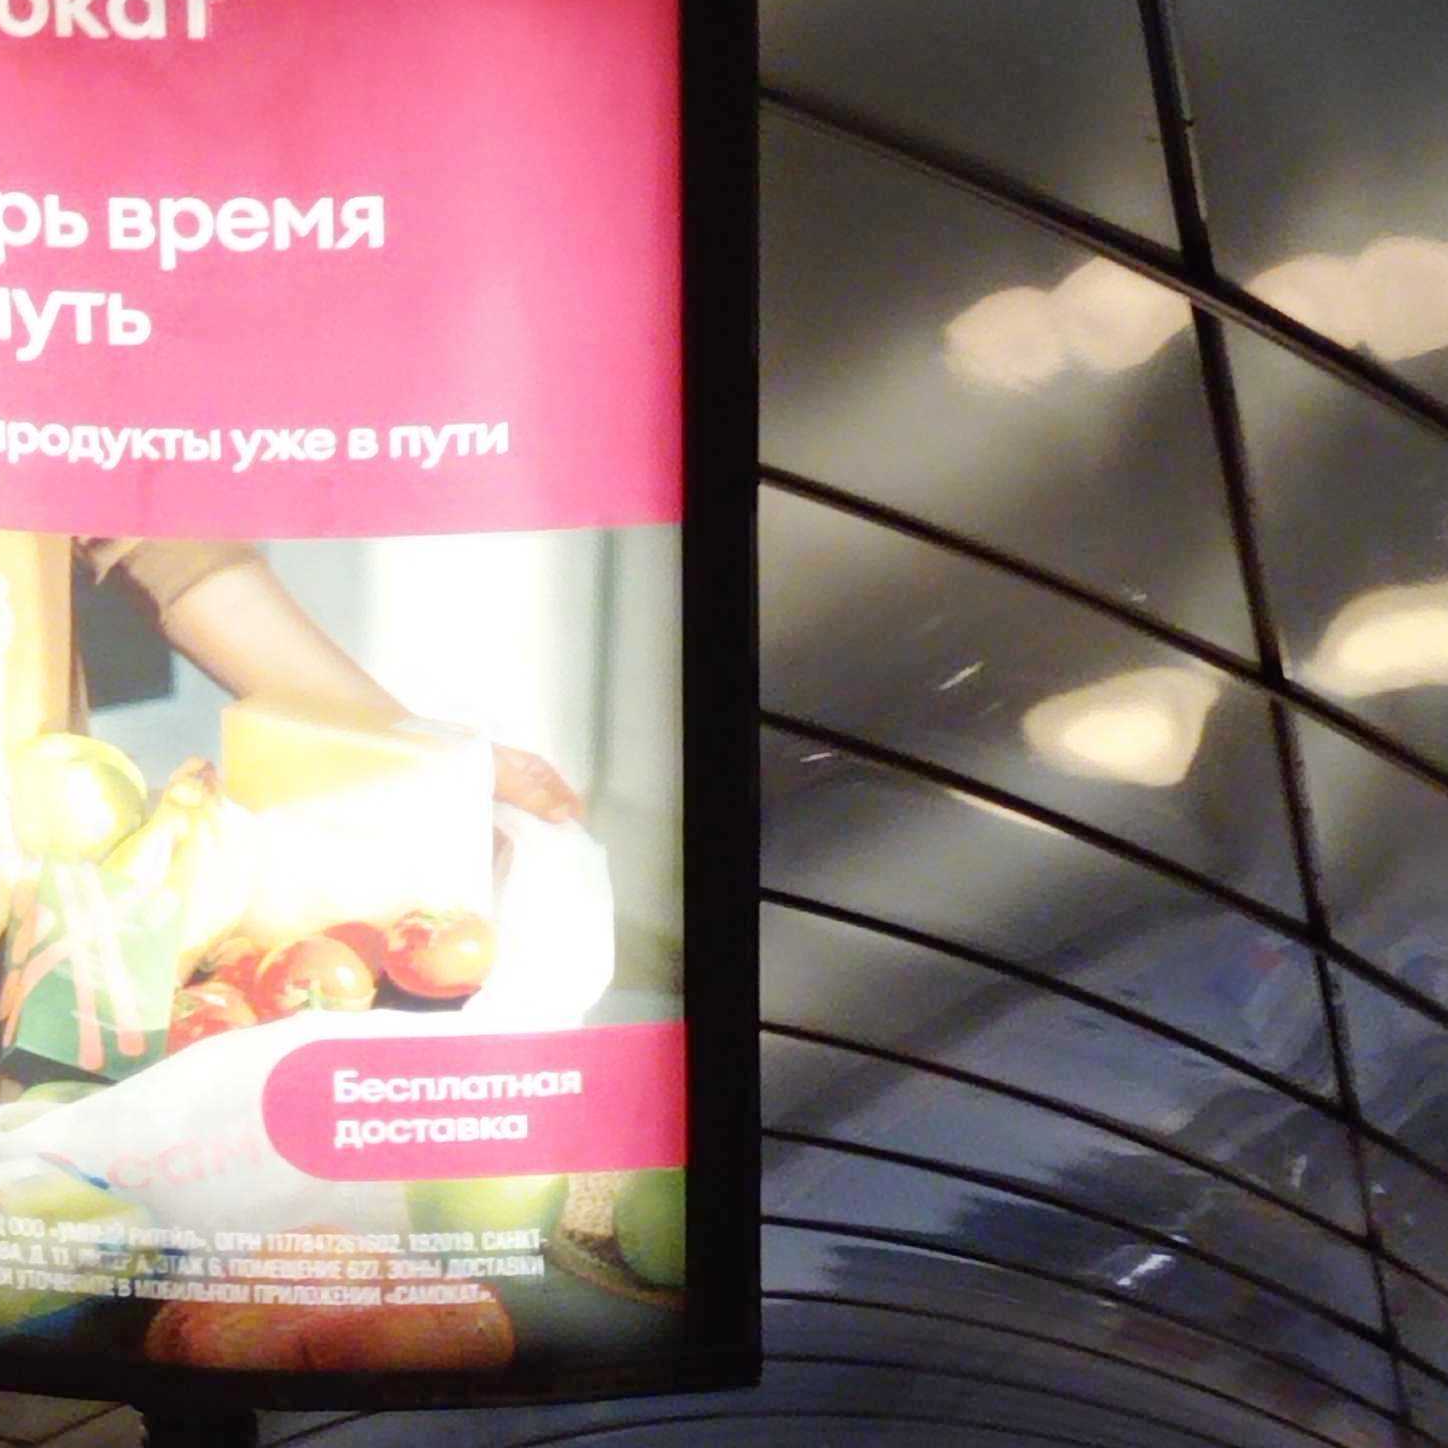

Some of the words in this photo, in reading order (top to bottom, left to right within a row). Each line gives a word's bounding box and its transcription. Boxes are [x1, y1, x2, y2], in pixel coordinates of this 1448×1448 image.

[108, 189, 386, 269] время
[231, 419, 335, 471] уже
[350, 421, 378, 462] в
[389, 419, 509, 469] пути
[332, 1066, 582, 1107] Бесплатная
[332, 1108, 529, 1150] доставка
